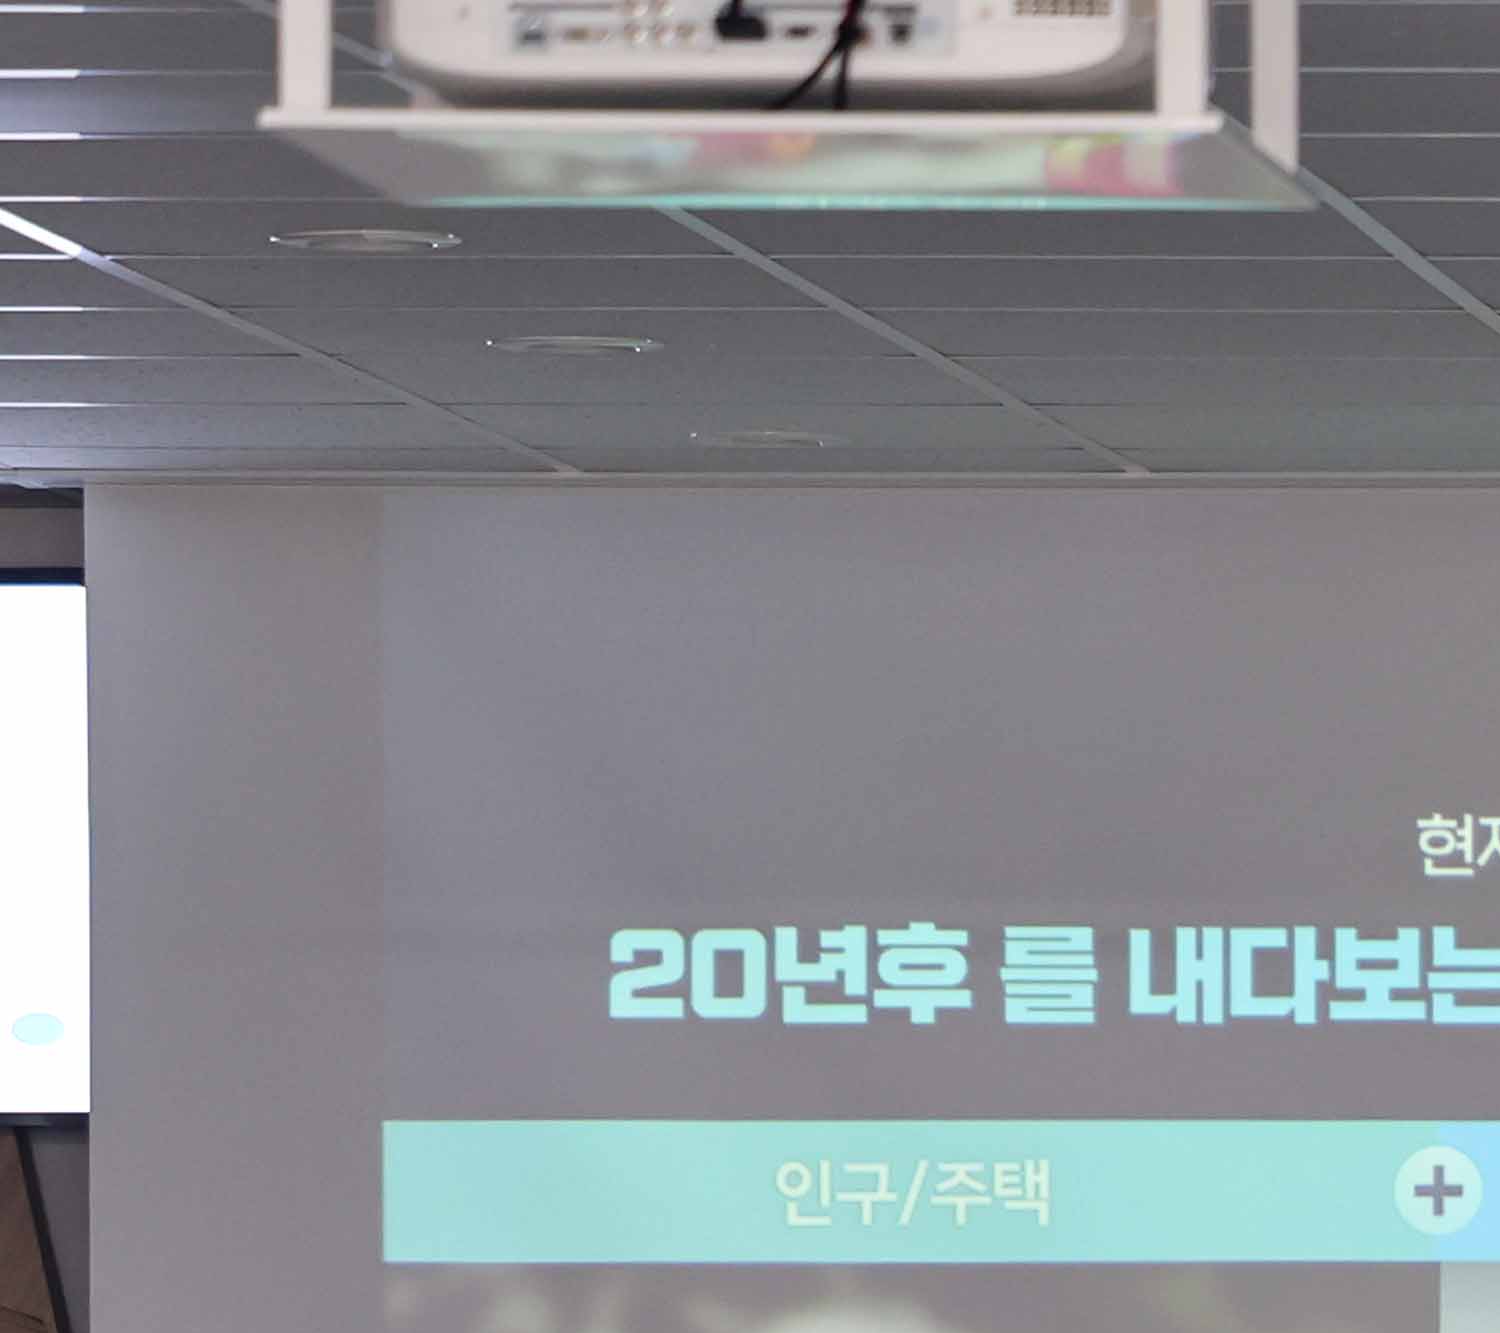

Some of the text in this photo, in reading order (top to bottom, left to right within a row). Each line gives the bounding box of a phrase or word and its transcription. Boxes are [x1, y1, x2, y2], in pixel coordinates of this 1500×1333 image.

[608, 922, 973, 1026] 20년후
[999, 923, 1099, 1026] 를
[774, 1157, 1052, 1227] 인구/주택
